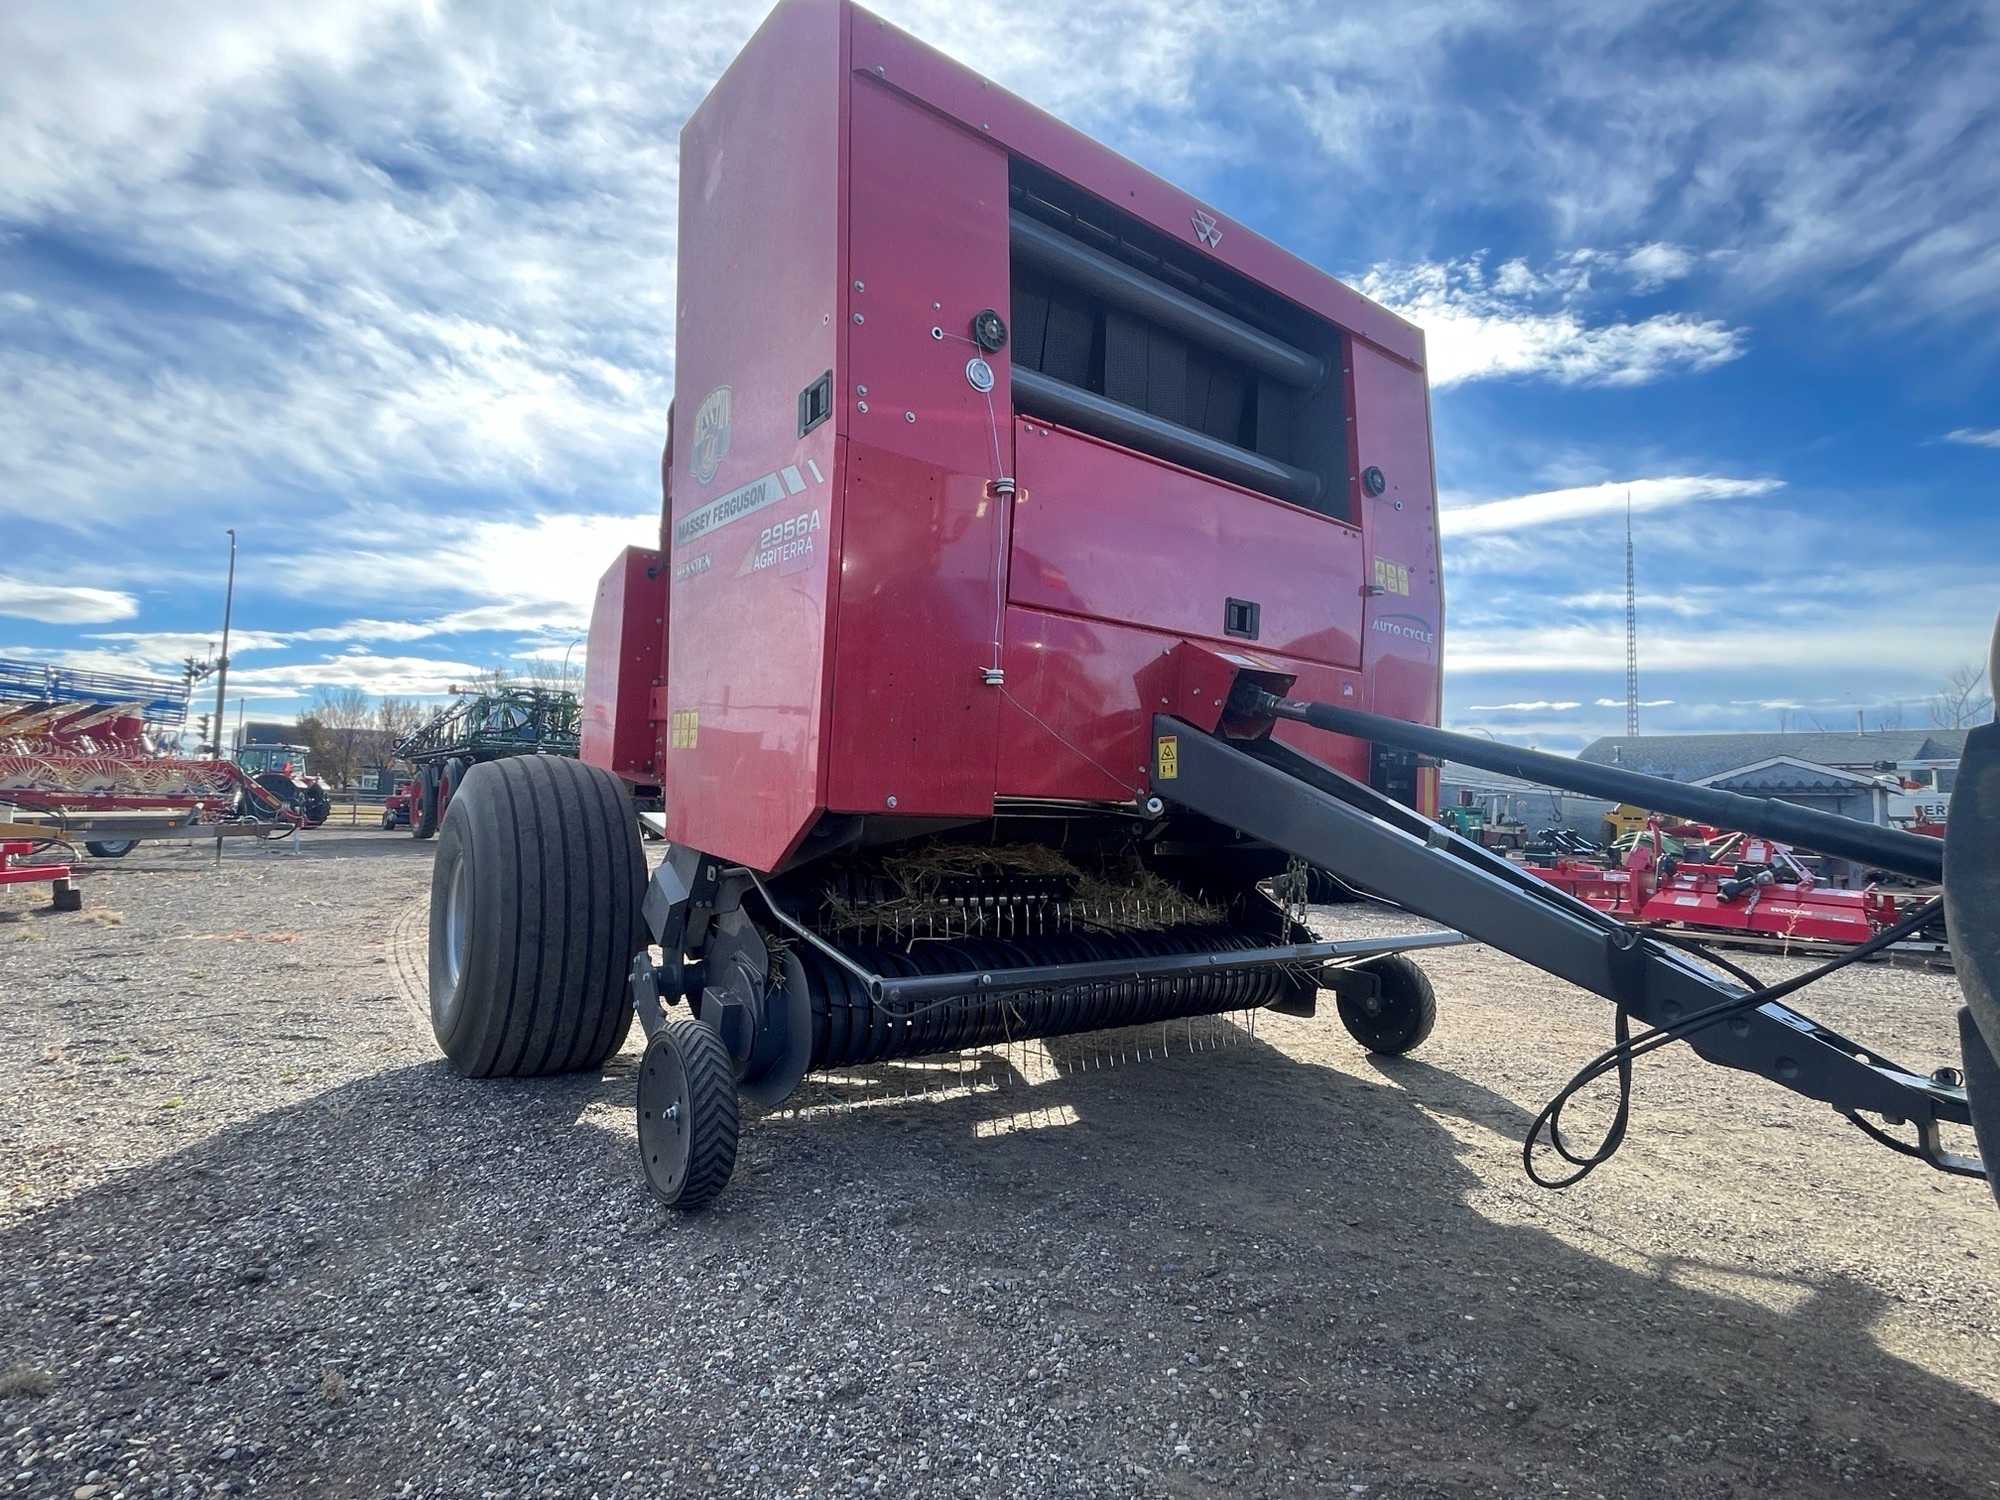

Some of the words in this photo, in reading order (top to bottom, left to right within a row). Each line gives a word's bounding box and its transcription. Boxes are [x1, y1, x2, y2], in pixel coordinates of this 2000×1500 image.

[677, 508, 711, 541] MASSEY
[713, 483, 765, 524] FERGUSON
[760, 509, 821, 549] 2956A
[753, 537, 813, 570] AGRITERRA
[1372, 619, 1400, 634] AUTO
[1403, 627, 1433, 643] CYCLE
